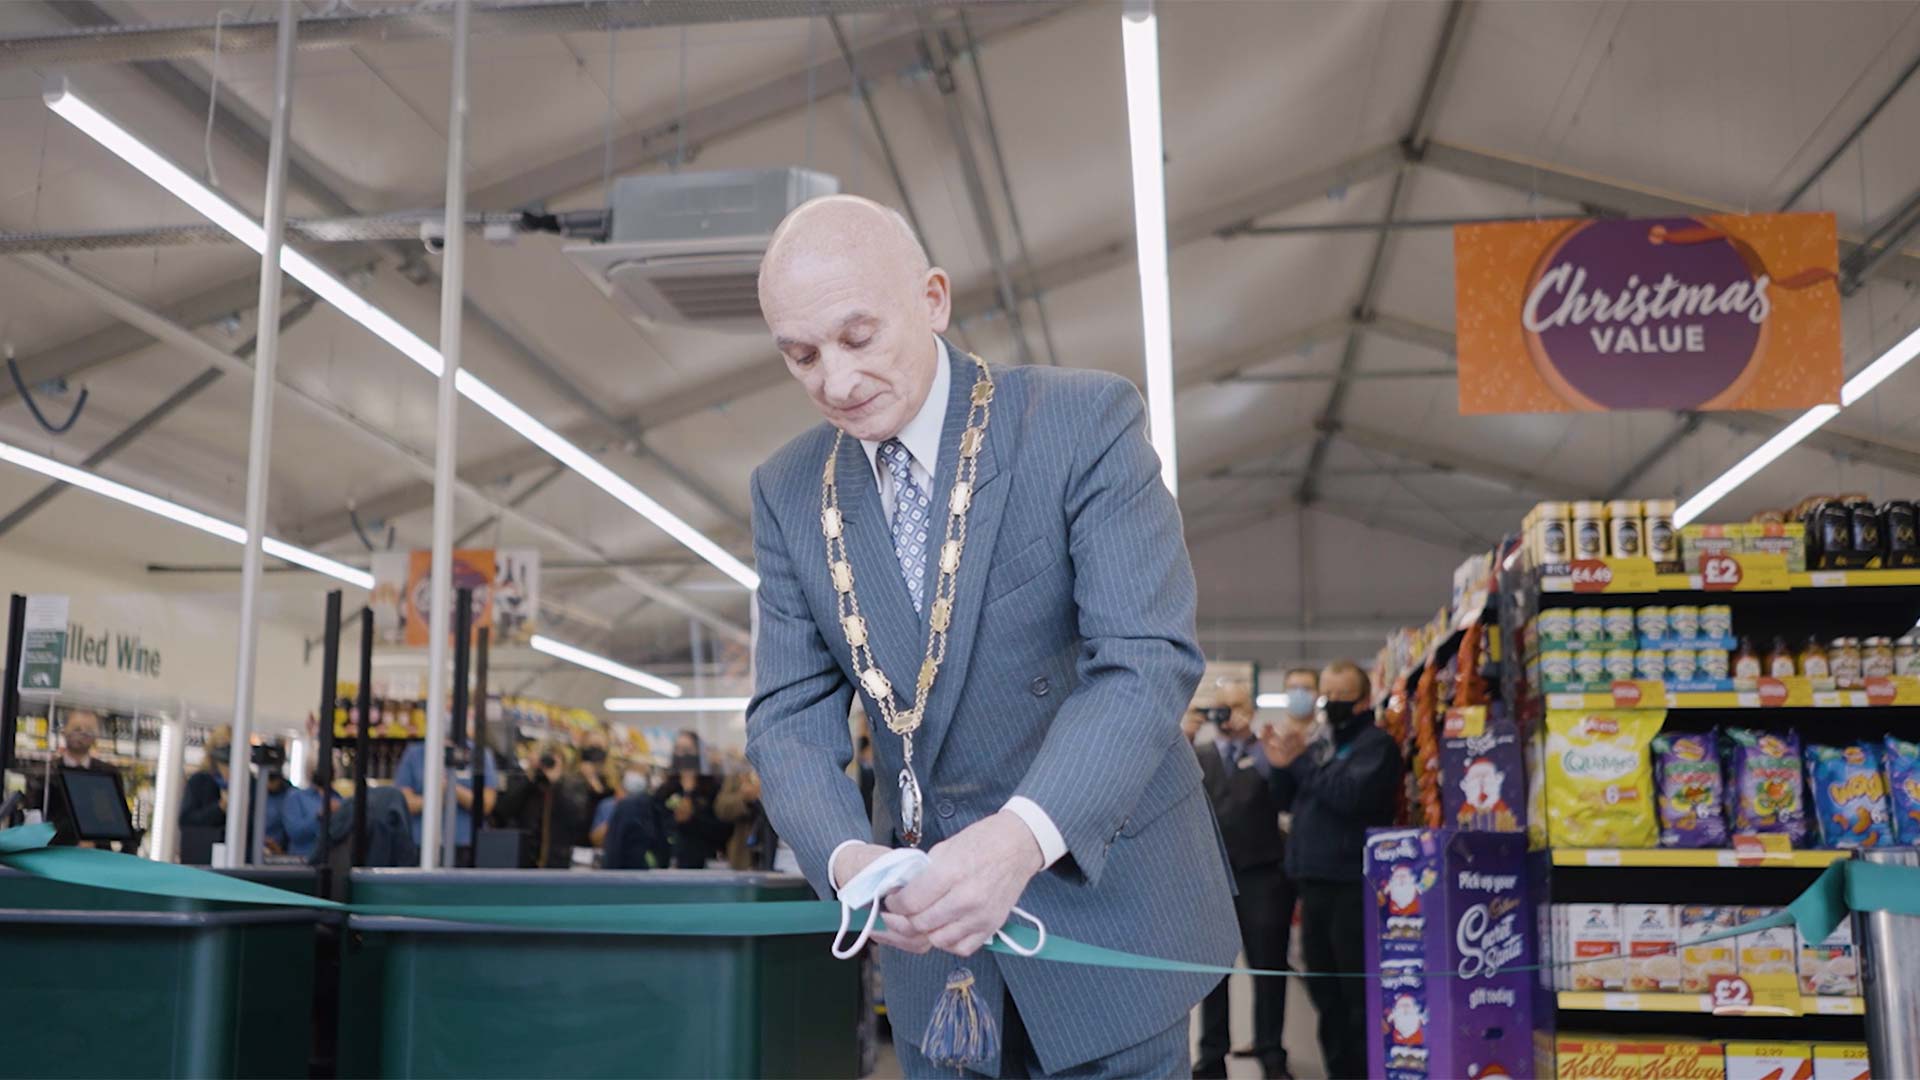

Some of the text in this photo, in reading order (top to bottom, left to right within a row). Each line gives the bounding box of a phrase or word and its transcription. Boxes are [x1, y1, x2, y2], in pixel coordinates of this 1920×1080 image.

[1522, 262, 1771, 334] Christmas
[1590, 325, 1706, 354] VALUE
[1572, 566, 1612, 583] £4.49
[1705, 557, 1739, 584] £2
[116, 630, 161, 679] Wine
[1714, 978, 1749, 1006] £2
